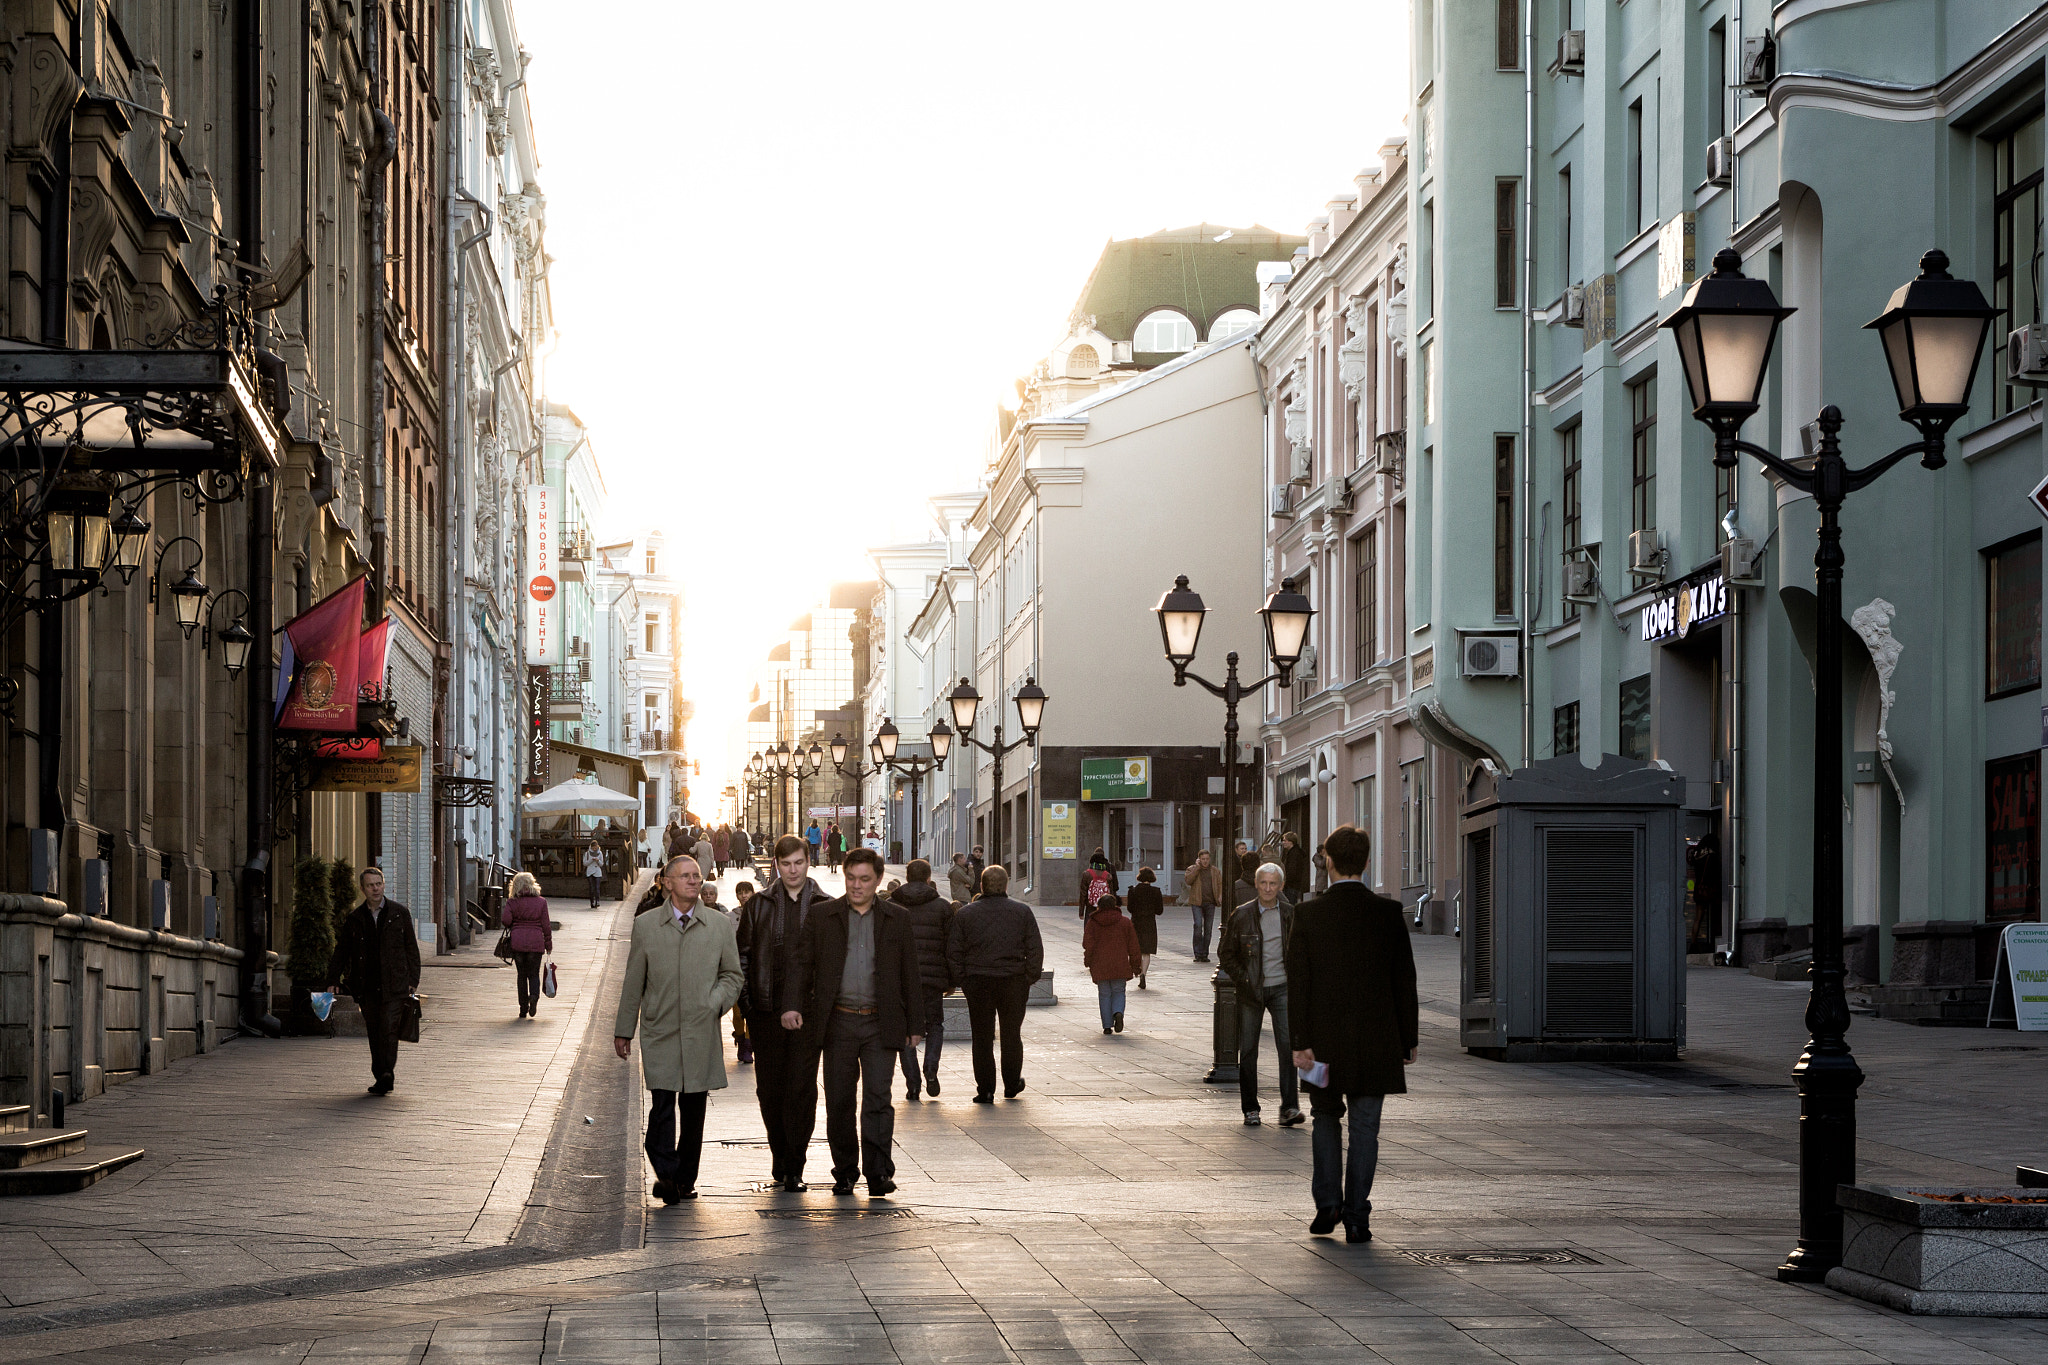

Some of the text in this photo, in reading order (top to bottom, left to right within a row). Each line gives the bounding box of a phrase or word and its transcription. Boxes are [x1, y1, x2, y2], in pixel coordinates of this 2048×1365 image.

[539, 491, 547, 571] ЯЗЫКОВОЙ
[1642, 575, 1726, 641] КОФЕ ХАУЗ
[1083, 772, 1124, 781] ТУРИСТИЧЕСКИЙ
[1992, 771, 2036, 832] SALE
